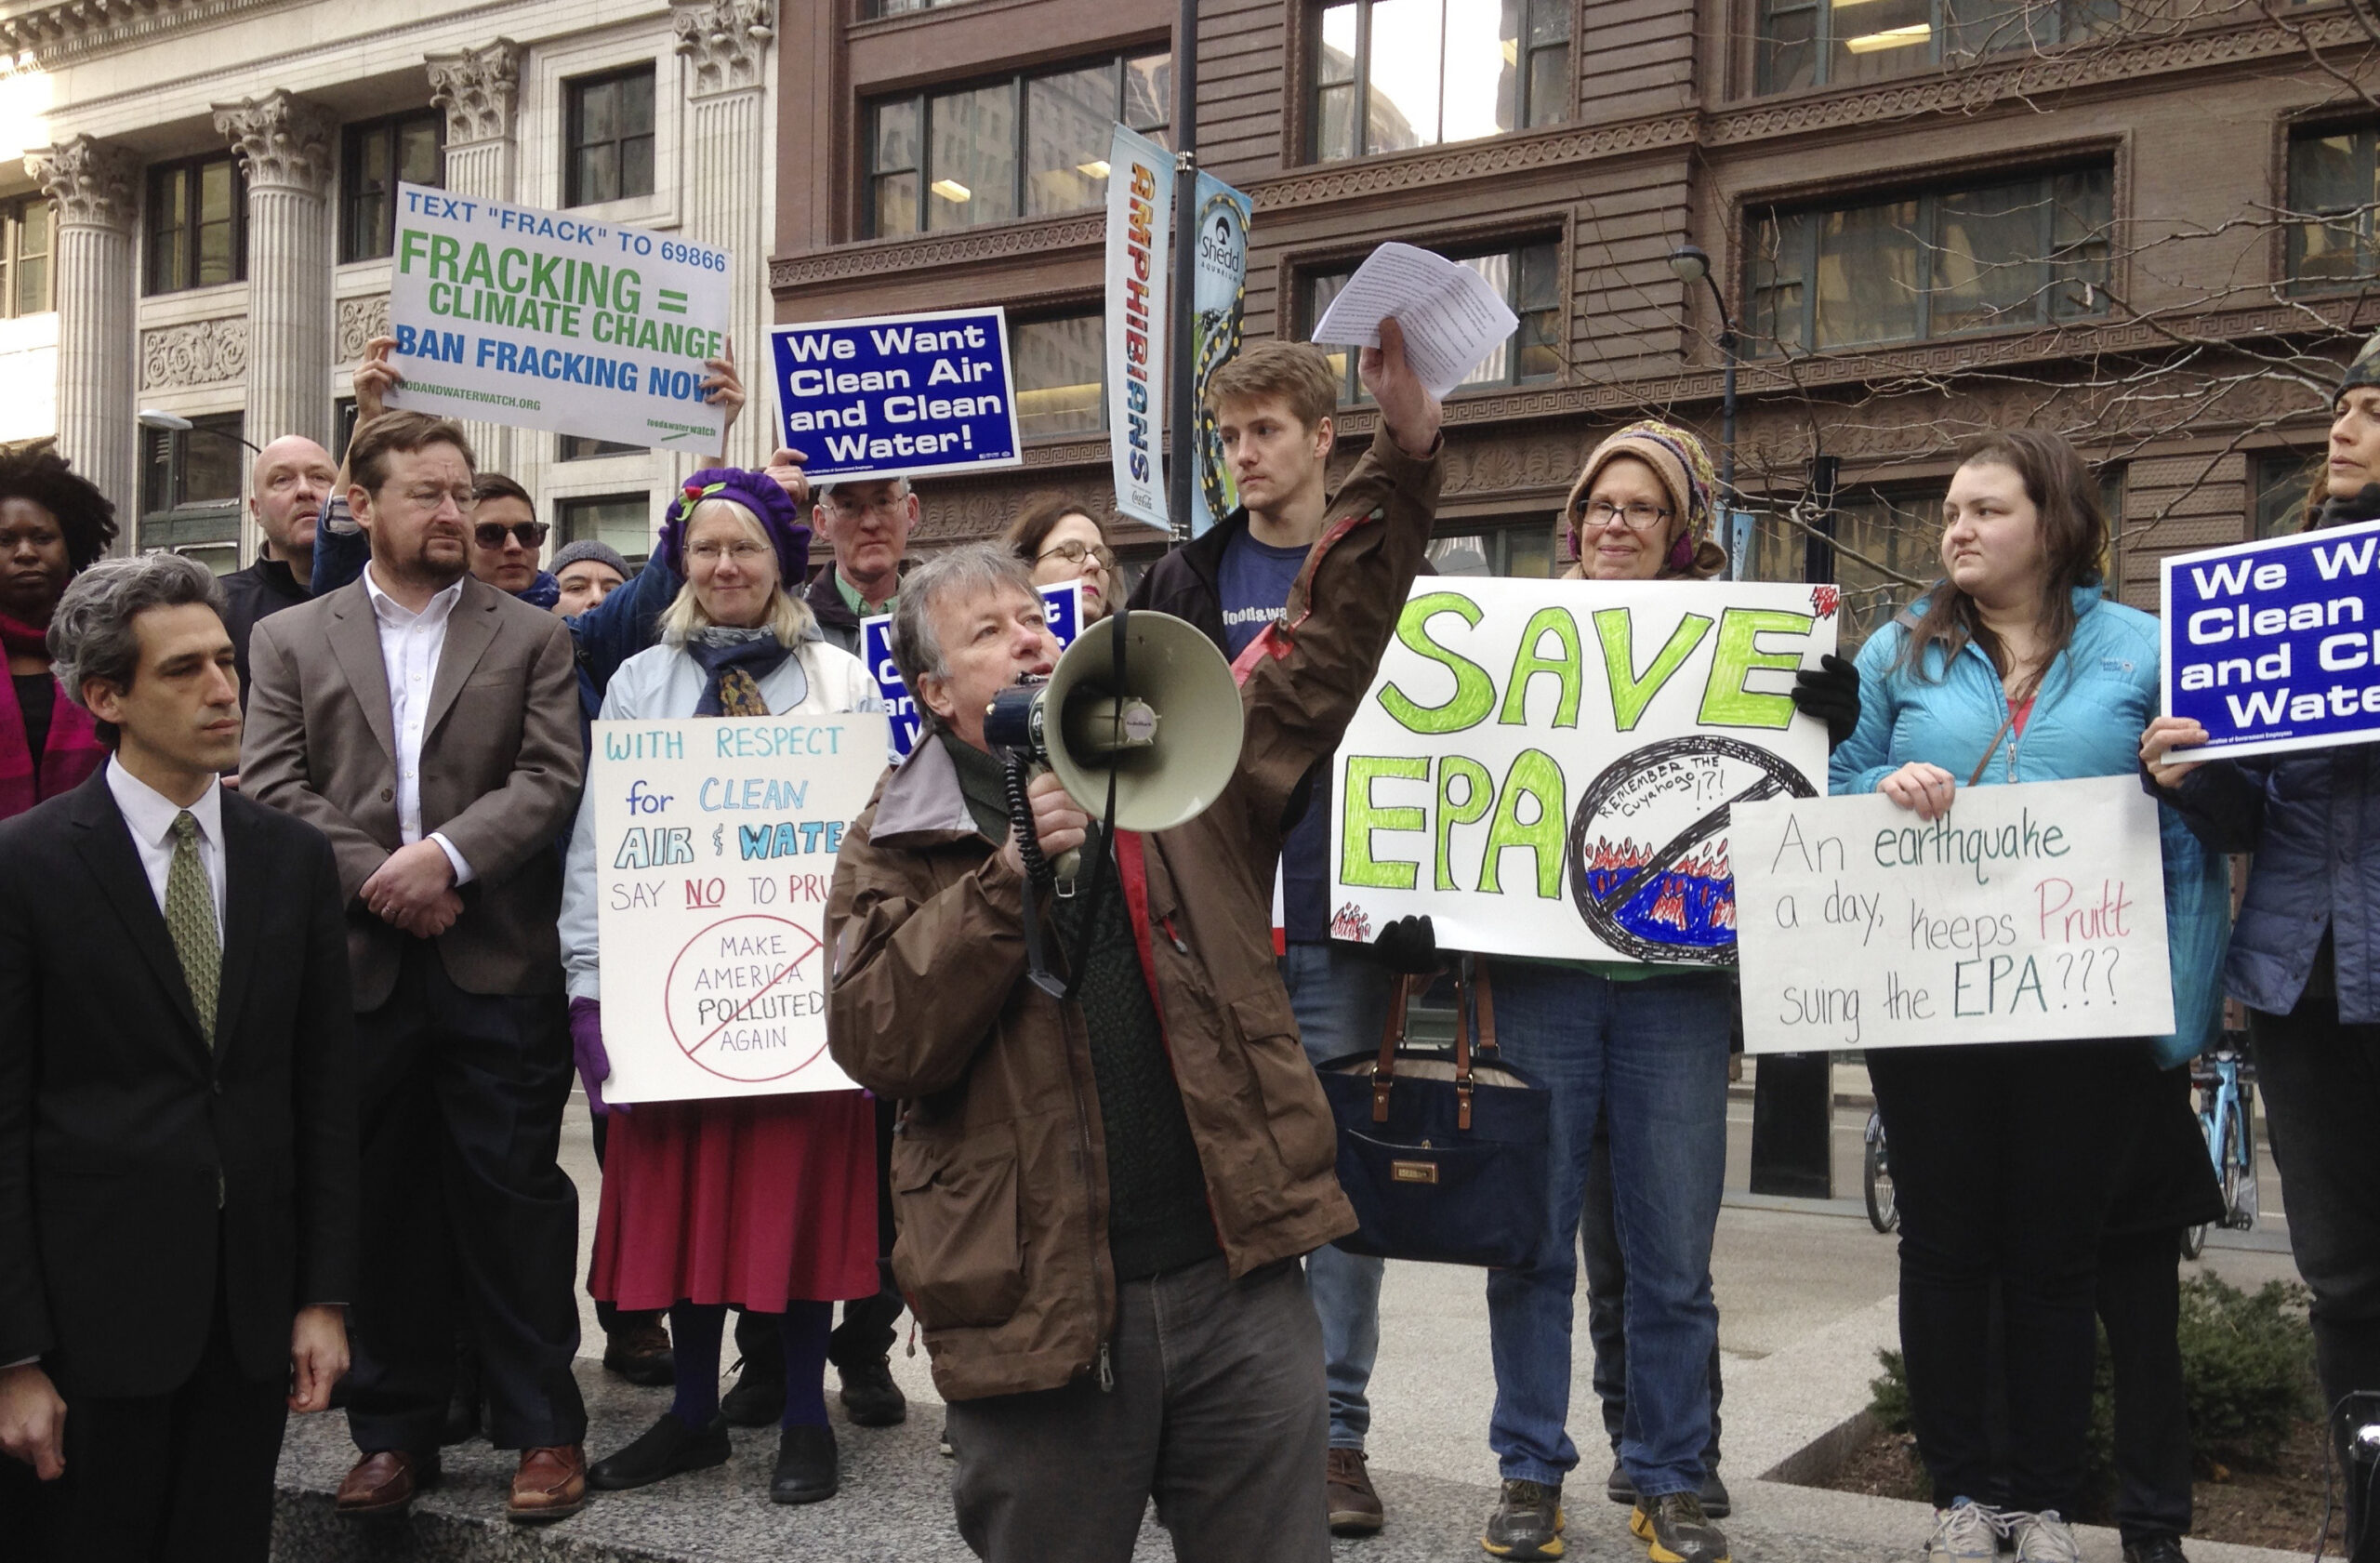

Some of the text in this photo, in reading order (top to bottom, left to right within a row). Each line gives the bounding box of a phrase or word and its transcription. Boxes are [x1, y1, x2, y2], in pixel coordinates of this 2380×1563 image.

[405, 192, 726, 272] TEXT "FRACK" TO 69866
[1201, 236, 1239, 272] Shedd
[400, 229, 641, 314] FRACKING
[429, 282, 722, 360] CLIMATE CHANGE
[787, 325, 985, 363] We Want
[1126, 162, 1156, 483] AMPHIBIANS
[396, 324, 465, 364] BAN
[476, 338, 638, 392] FRACKING
[790, 357, 993, 397] Clean Air
[395, 379, 541, 411] OODANDWATERWATCH.ORG
[790, 393, 1001, 431] and Clean
[825, 424, 973, 462] Water!
[2191, 537, 2380, 600] We W
[2188, 596, 2363, 645] Clean
[1376, 591, 1815, 735] SAVE
[2180, 642, 2291, 691] and
[605, 726, 844, 761] WITH RESPECT
[626, 777, 808, 815] for CLEAN
[1598, 755, 1719, 819] REMEMBER THE
[614, 827, 694, 869] AIR
[738, 821, 855, 860] WATE
[1340, 748, 1567, 900] EPA
[1771, 807, 2071, 885] An earthquake
[611, 880, 666, 910] SAY
[685, 877, 726, 907] NO
[748, 877, 777, 906] TO
[1776, 878, 2133, 961] a day, keeps Pruitt
[721, 934, 787, 958] MAKE
[694, 963, 803, 991] AMERICA
[698, 991, 824, 1026] POLLUTED
[1780, 979, 1860, 1043] suing
[1883, 971, 1936, 1021] the
[720, 1027, 787, 1052] AGAIN
